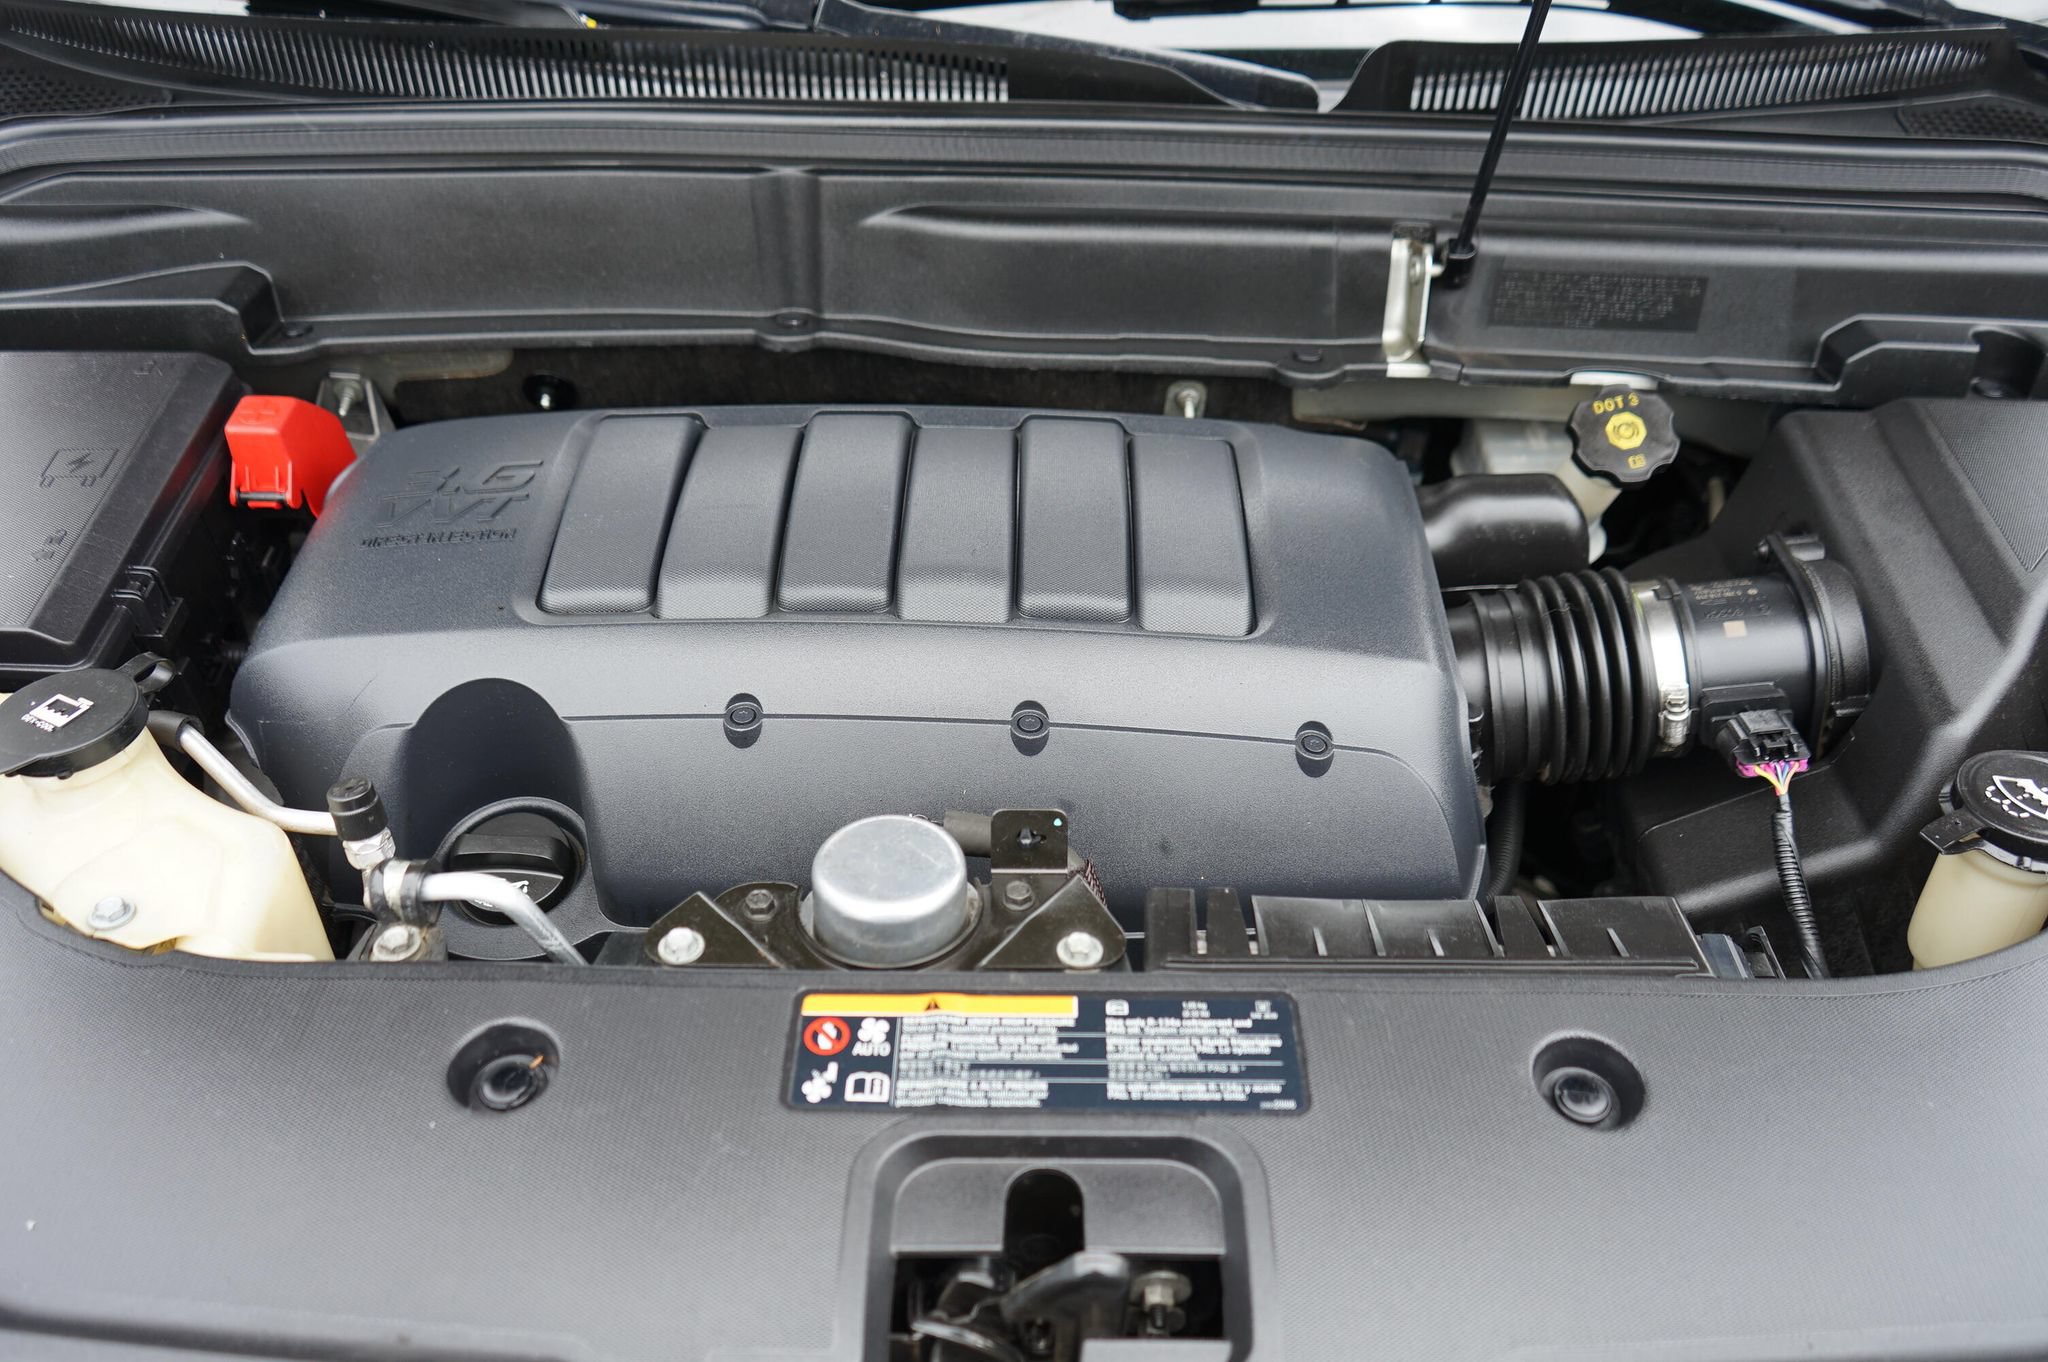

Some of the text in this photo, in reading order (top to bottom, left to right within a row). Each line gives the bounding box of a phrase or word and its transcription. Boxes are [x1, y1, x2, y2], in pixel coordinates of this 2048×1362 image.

[1593, 391, 1640, 415] DOT 3
[382, 460, 545, 500] 3.6
[374, 493, 531, 528] VVT
[361, 527, 518, 550] DIRECT INJECTION
[851, 1038, 892, 1057] AUTO
